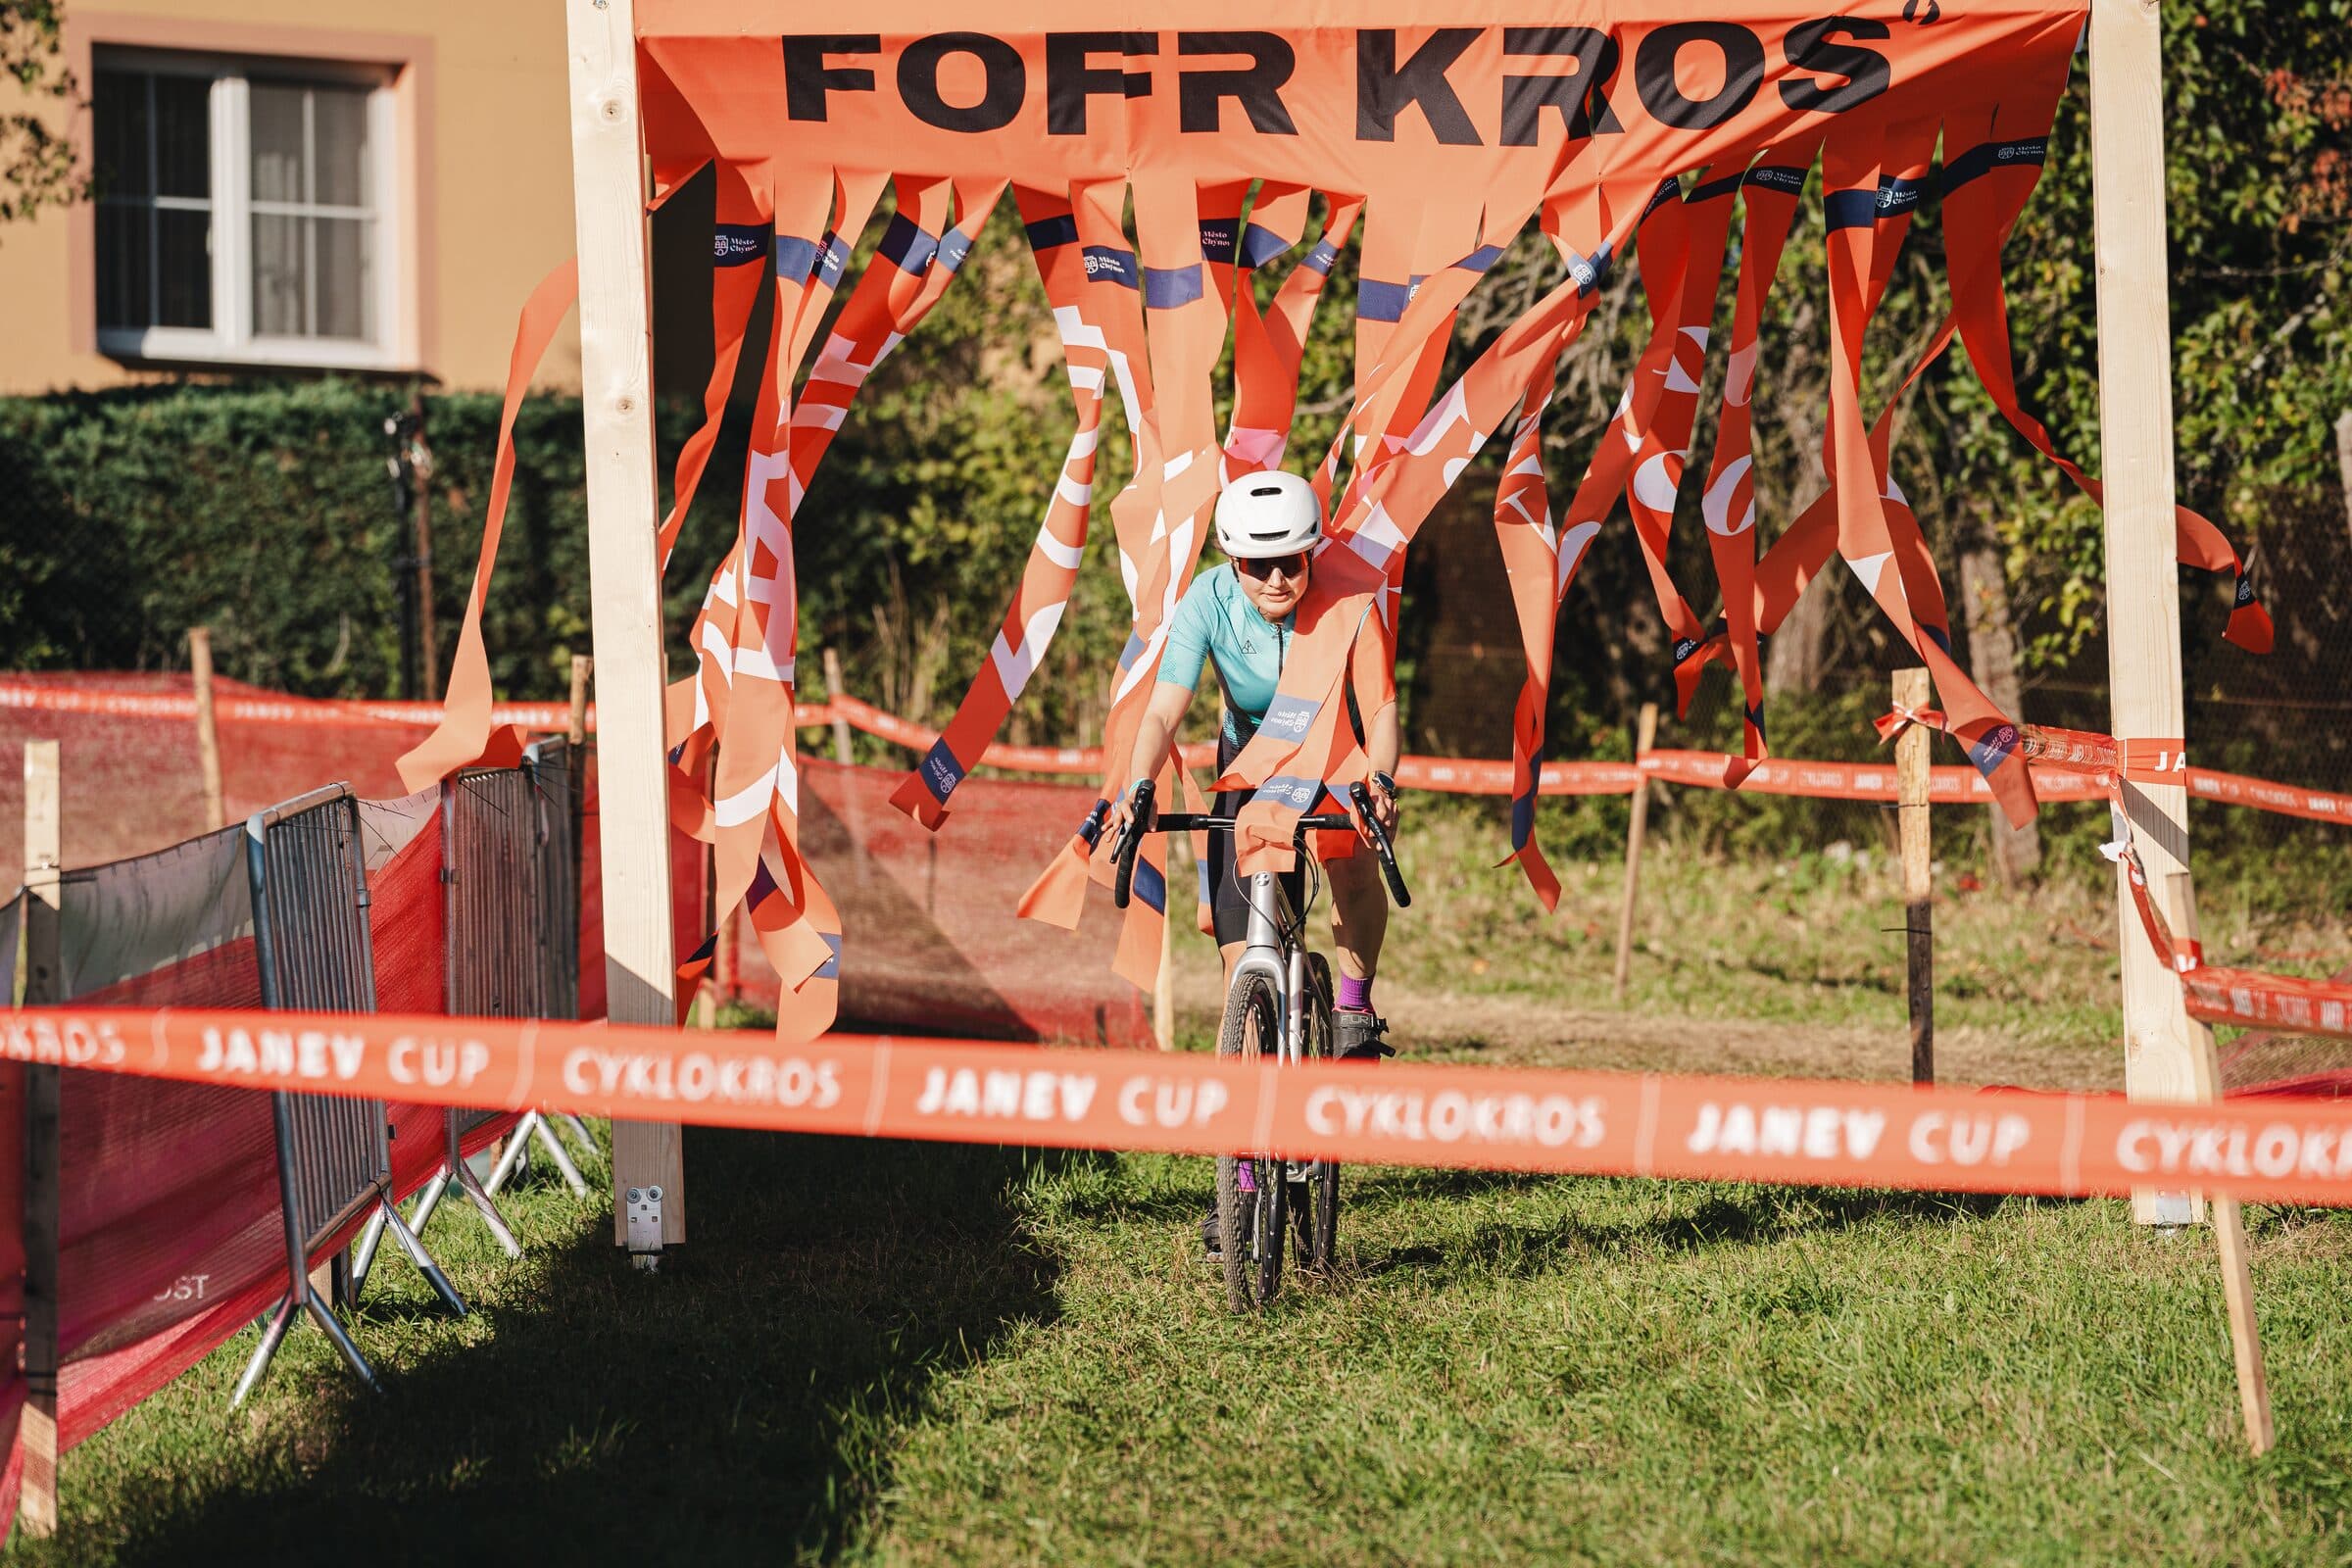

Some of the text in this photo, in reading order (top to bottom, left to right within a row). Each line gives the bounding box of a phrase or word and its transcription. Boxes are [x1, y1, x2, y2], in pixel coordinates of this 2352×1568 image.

[781, 16, 1891, 147] FOFR KROS
[0, 1014, 126, 1065] KROS
[198, 1025, 365, 1079] JANEV
[389, 1036, 490, 1088] CUP
[562, 1047, 843, 1109] CYKLOKROS
[915, 1066, 1097, 1122] JANEV
[1117, 1077, 1229, 1129] CUP
[1304, 1084, 1608, 1149] CYKLOKROS
[1687, 1102, 1887, 1161] JANEV
[1907, 1109, 2032, 1167] CUP
